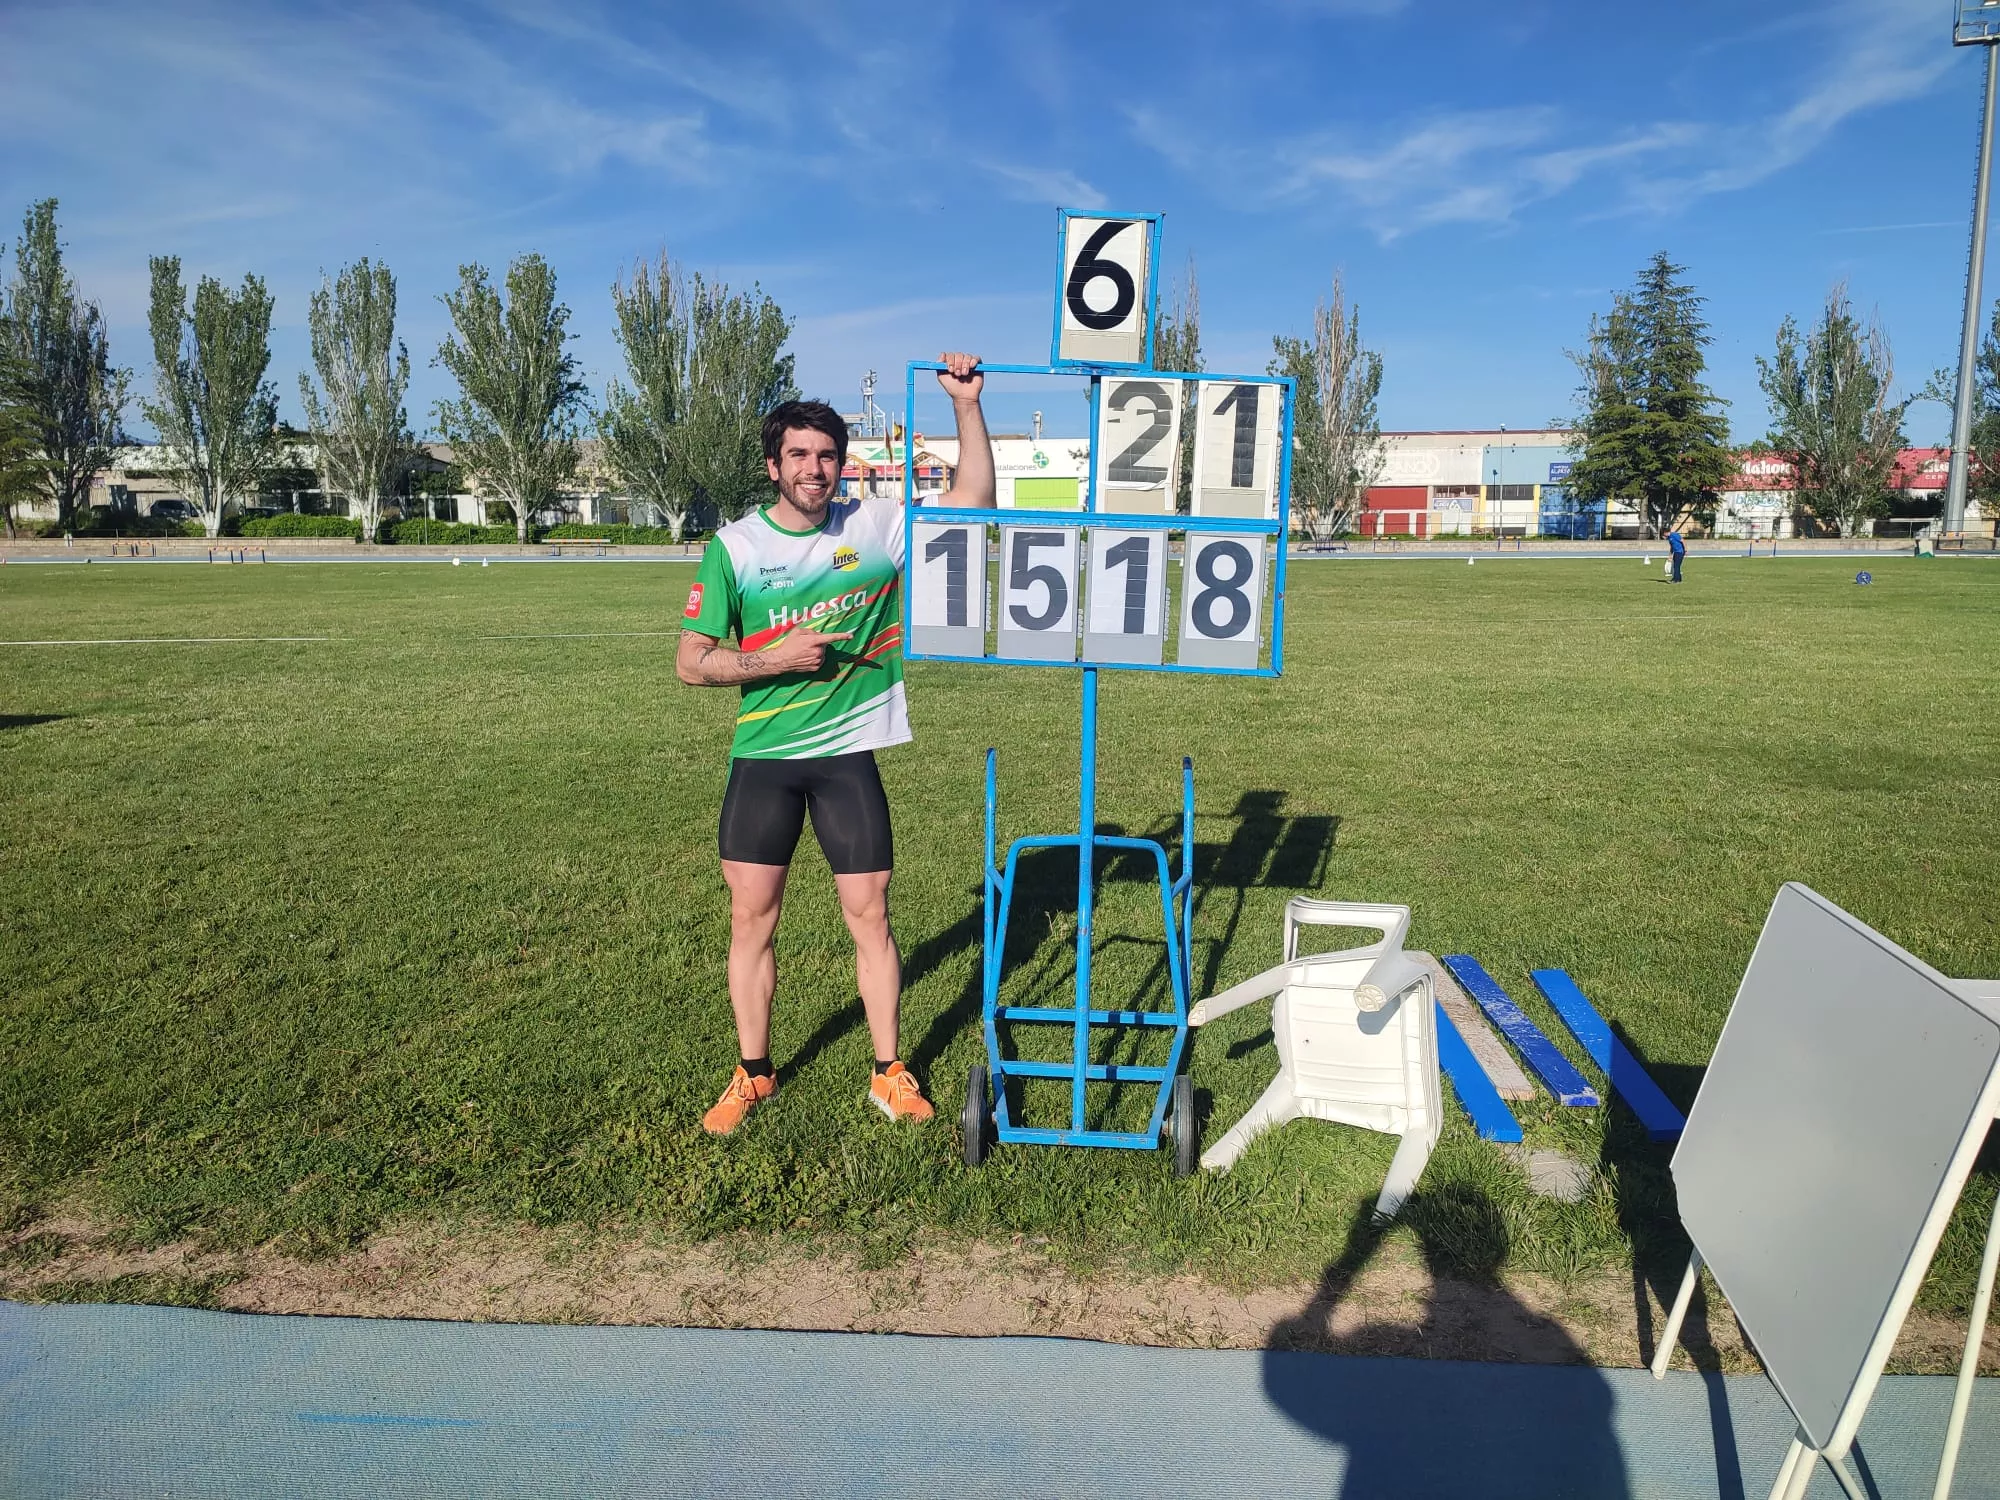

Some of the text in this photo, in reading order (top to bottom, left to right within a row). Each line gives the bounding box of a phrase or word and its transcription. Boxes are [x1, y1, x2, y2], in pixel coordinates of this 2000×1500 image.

[1066, 221, 1136, 331] 6
[996, 463, 1038, 472] stalaciones
[768, 589, 867, 630] Huesca
